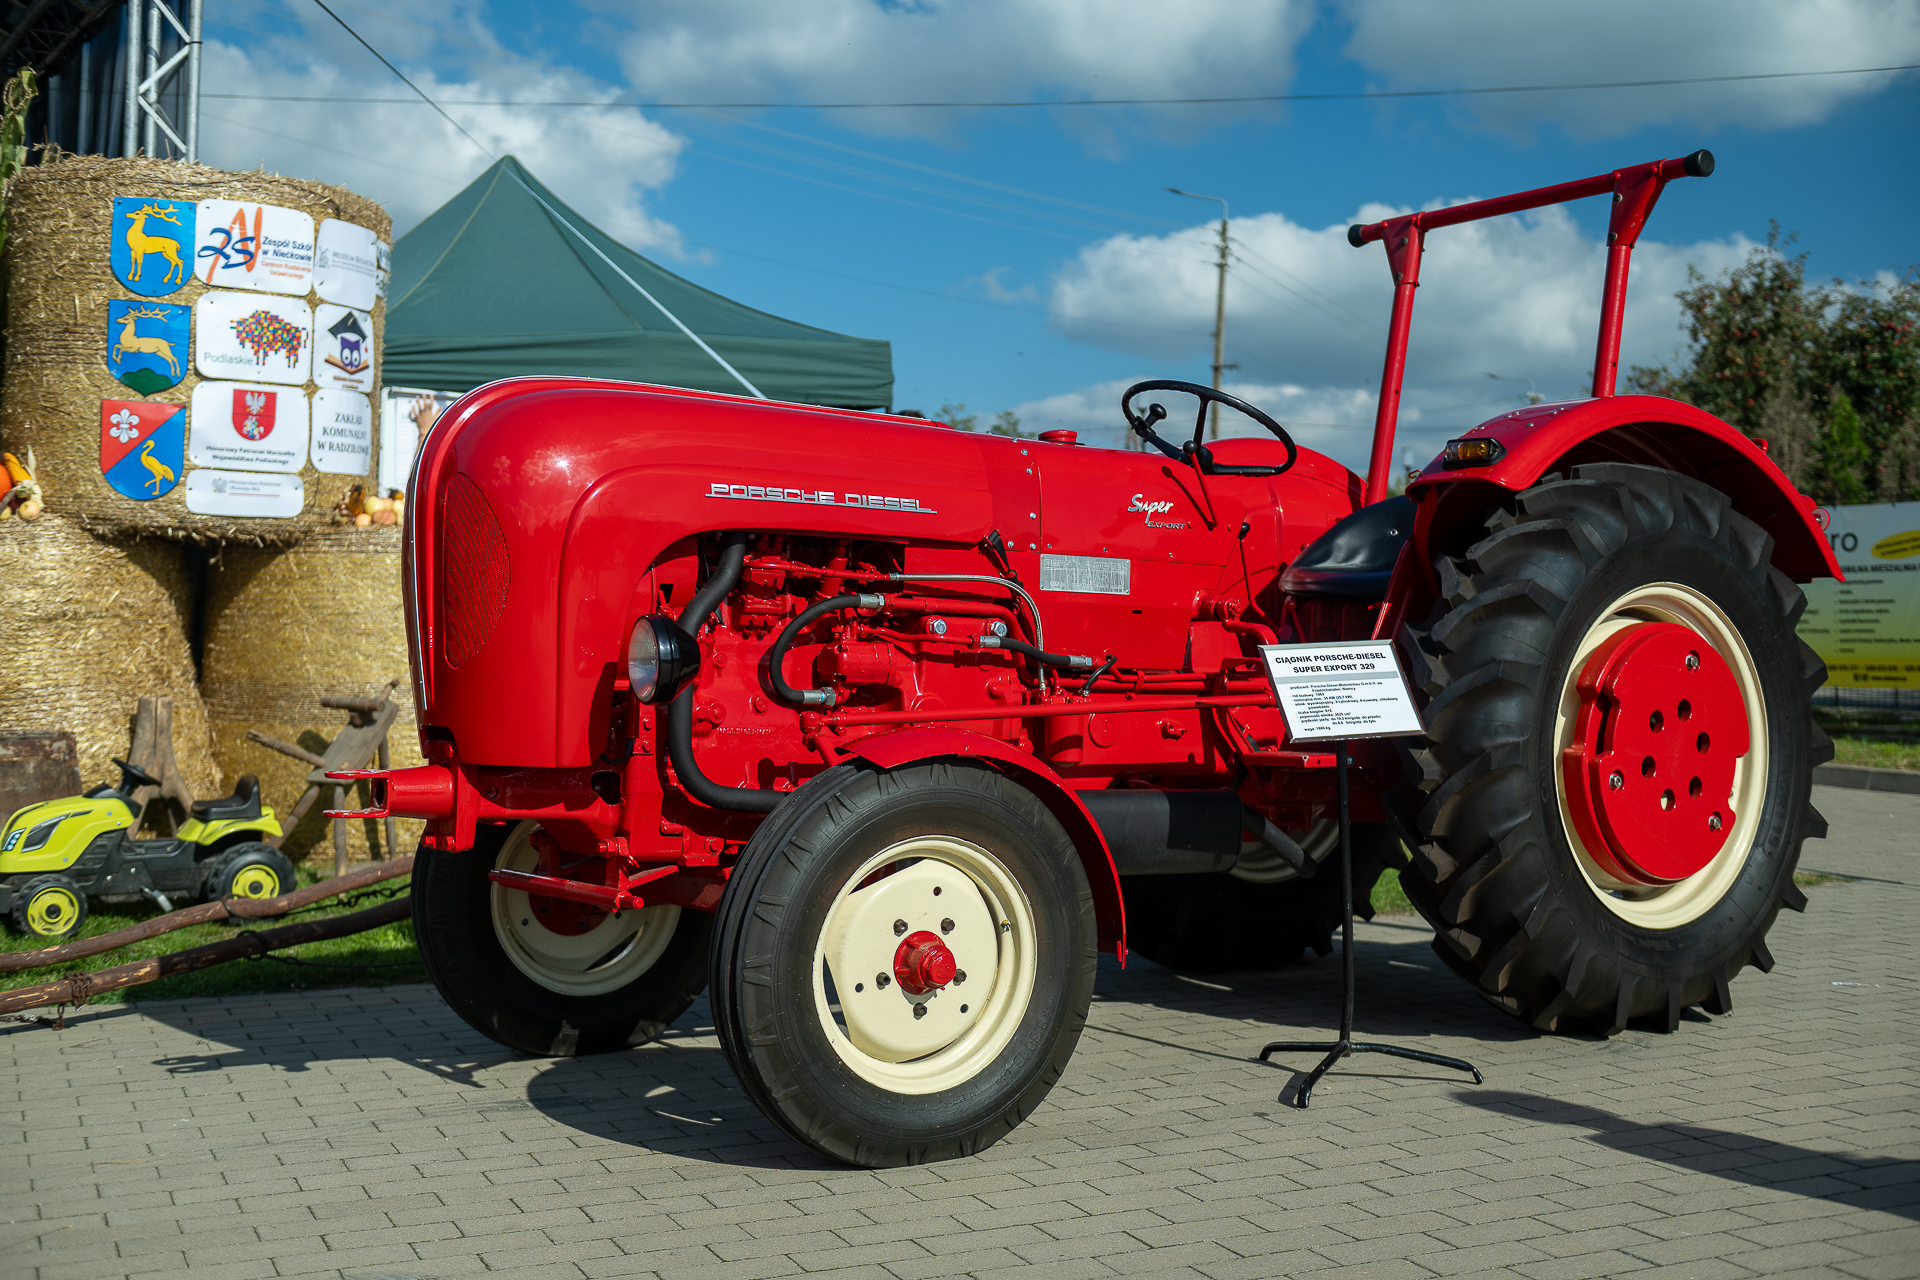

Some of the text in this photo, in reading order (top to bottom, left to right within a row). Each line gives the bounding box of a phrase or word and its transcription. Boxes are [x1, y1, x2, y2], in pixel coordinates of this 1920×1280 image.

[262, 236, 312, 251] Zespół Szkół
[272, 248, 312, 262] Niećkowie
[204, 352, 254, 366] Podlaskie
[317, 440, 327, 450] W
[256, 456, 289, 466] Podlaskiego
[710, 482, 932, 512] PORSCHE DIESEL
[1127, 493, 1174, 524] Super
[1146, 521, 1186, 530] EXPORT
[1275, 652, 1386, 664] CIĄGNIK PORSCHE-DIESEL
